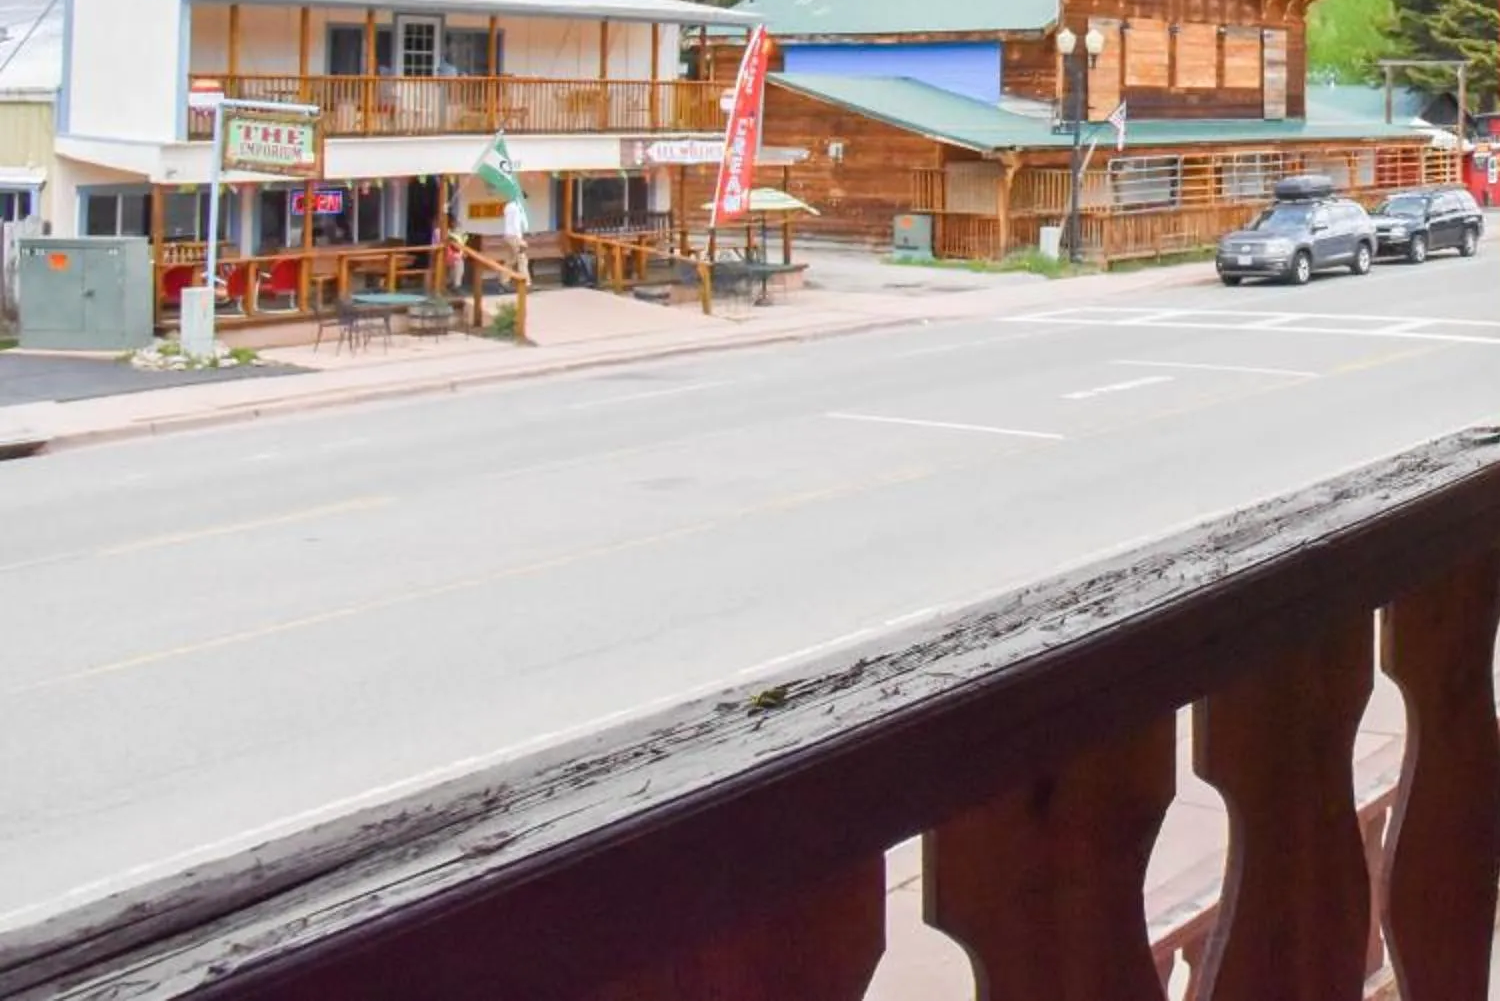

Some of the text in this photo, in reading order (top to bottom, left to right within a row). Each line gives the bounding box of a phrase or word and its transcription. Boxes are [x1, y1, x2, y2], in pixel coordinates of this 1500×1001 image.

[236, 124, 305, 146] THE
[722, 117, 748, 213] CREAM
[292, 193, 342, 213] OEN
